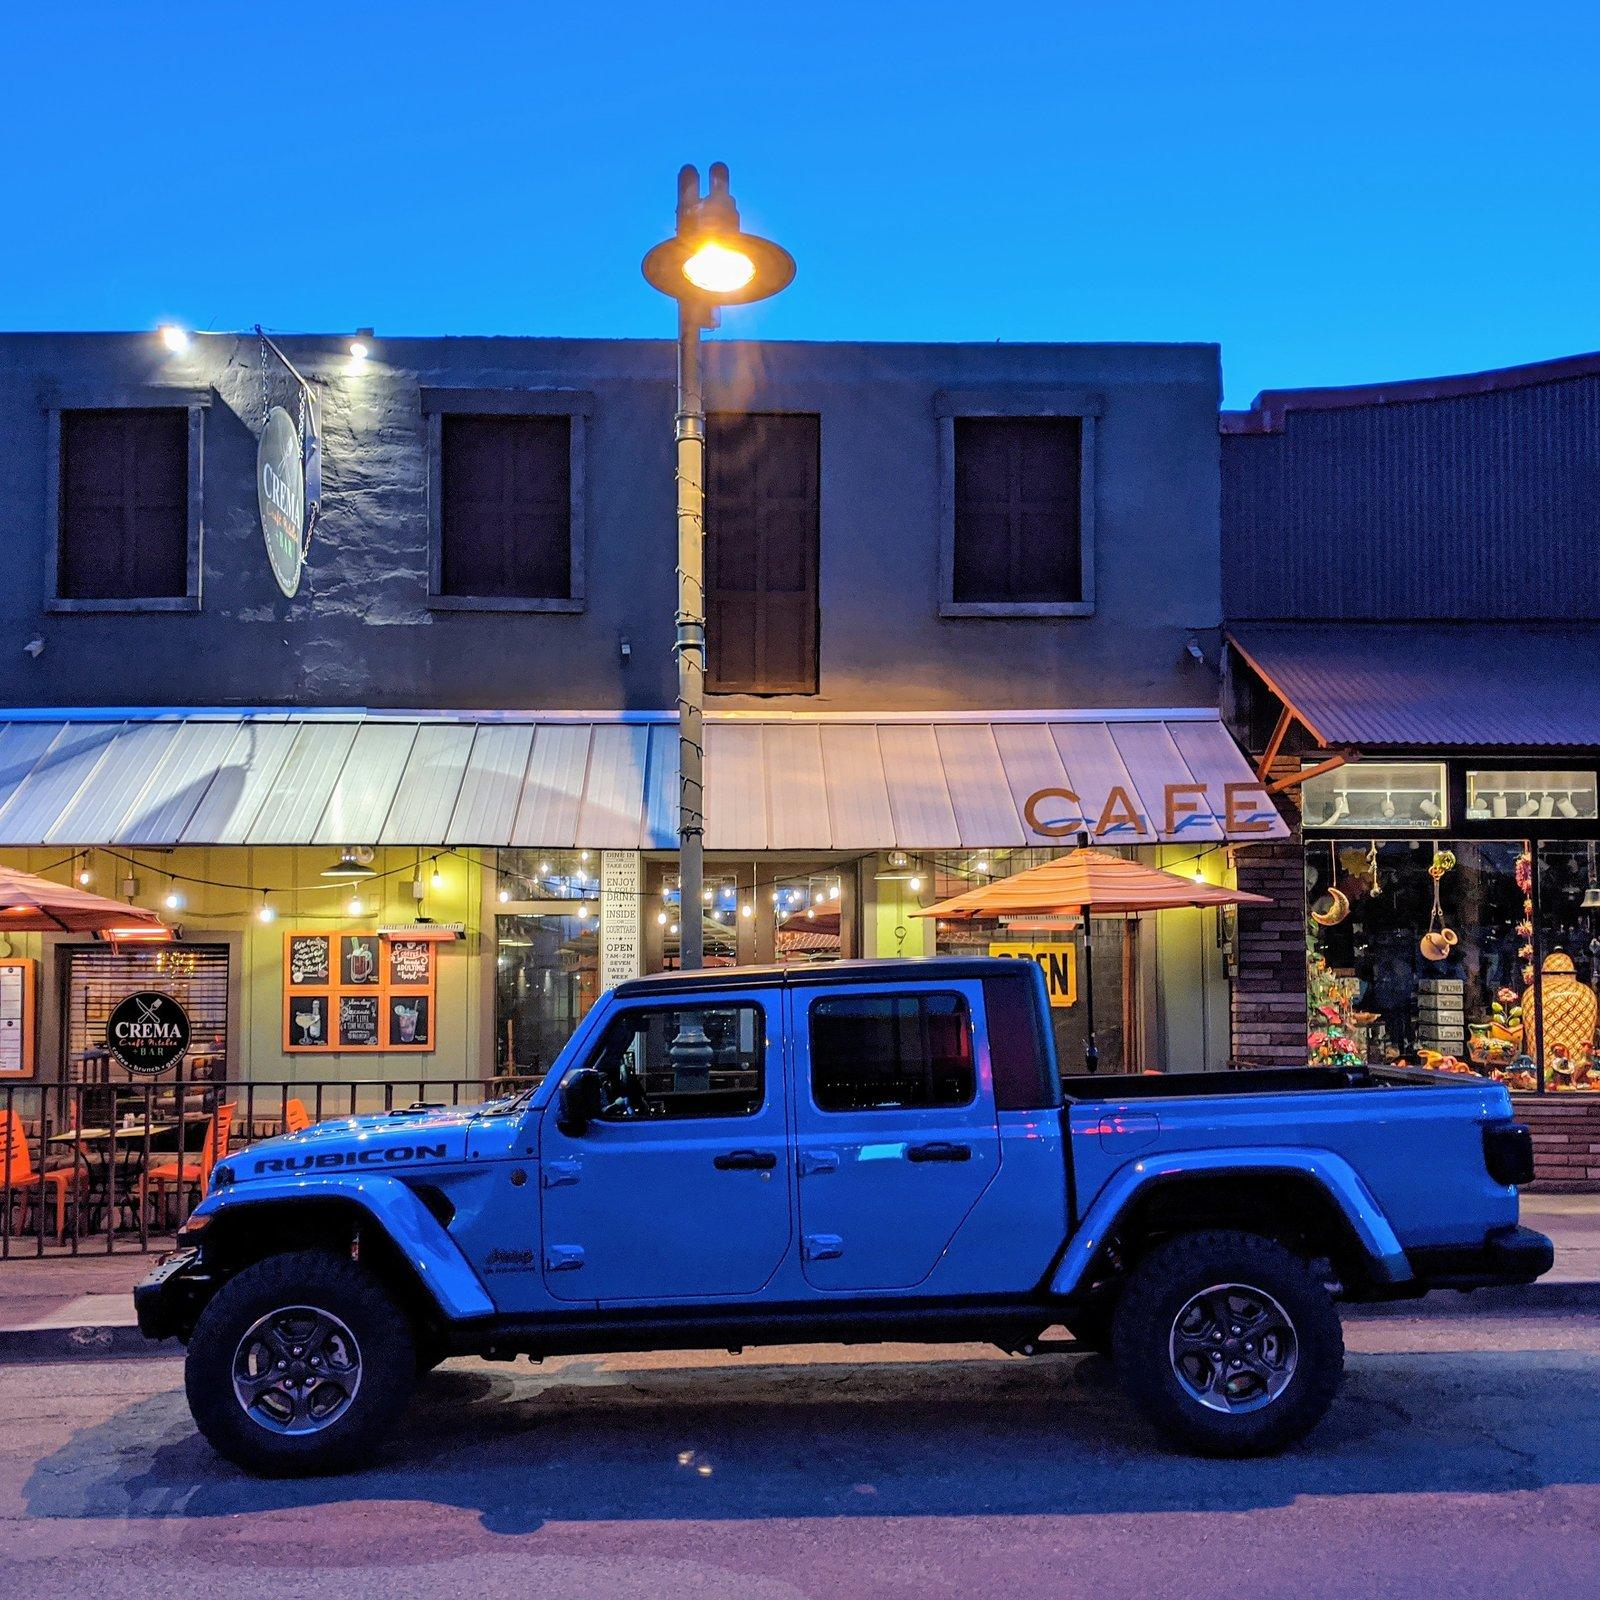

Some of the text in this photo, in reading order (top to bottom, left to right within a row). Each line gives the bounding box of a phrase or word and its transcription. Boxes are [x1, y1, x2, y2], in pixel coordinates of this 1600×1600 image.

[1023, 782, 1269, 837] CAFE
[606, 878, 636, 887] ENJOY
[606, 892, 636, 901] DRINK
[606, 910, 636, 919] INSIDE
[606, 925, 637, 934] COURTYARD
[606, 944, 634, 952] OPEN
[115, 1021, 182, 1038] CREMA
[119, 1039, 145, 1048] Craft
[133, 1064, 161, 1073] brunch
[254, 1144, 447, 1173] RUBICON
